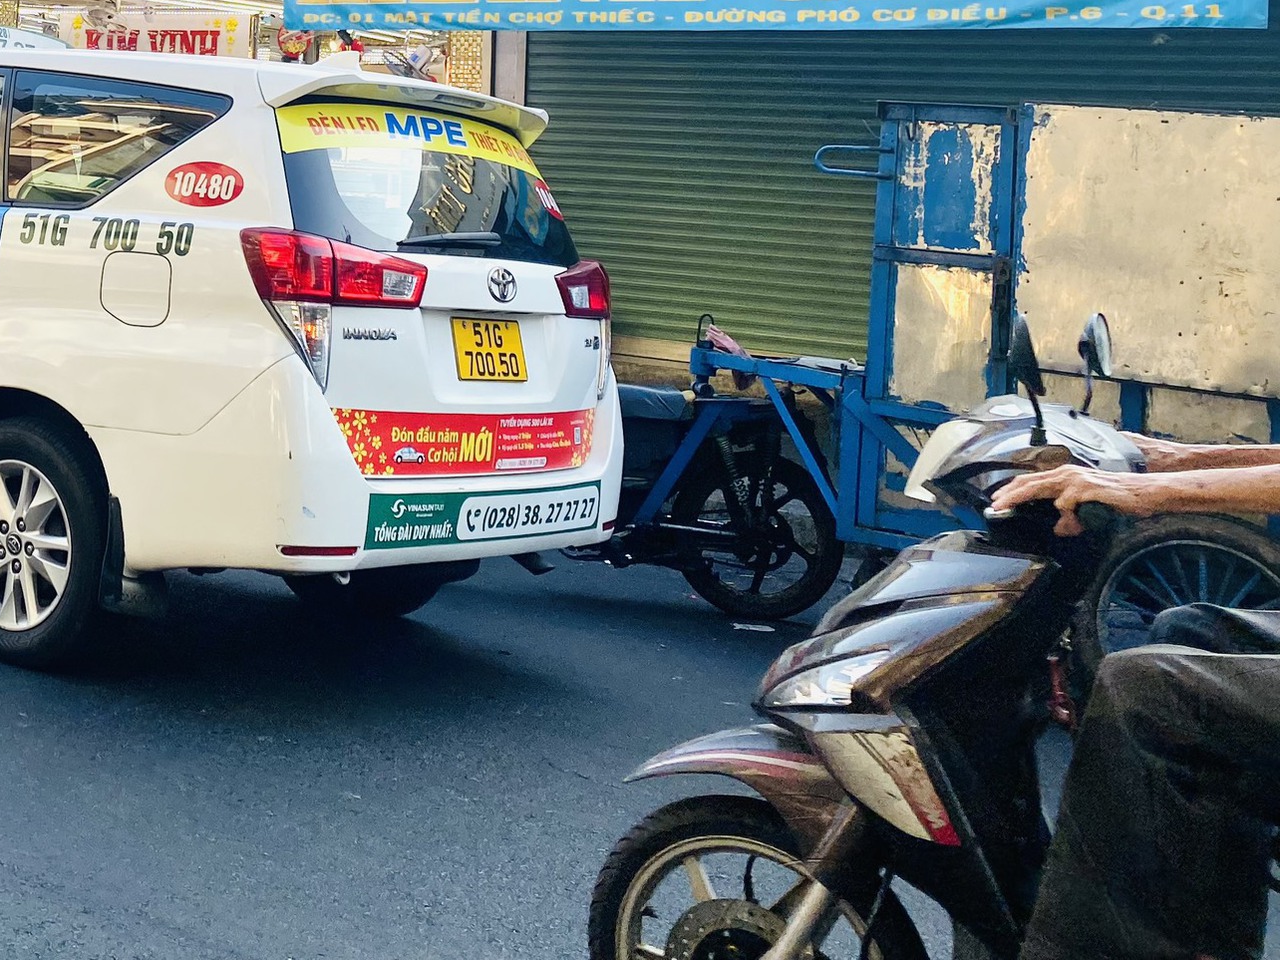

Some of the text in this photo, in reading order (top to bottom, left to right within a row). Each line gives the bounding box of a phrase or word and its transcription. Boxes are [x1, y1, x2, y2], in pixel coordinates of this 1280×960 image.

[509, 9, 563, 26] CHỢ
[572, 7, 655, 24] THIẾC
[684, 7, 786, 23] ĐƯỜNG
[872, 6, 918, 22] CƠ
[1045, 4, 1102, 20] P.6
[1141, 4, 1225, 20] Q.11
[85, 28, 220, 56] KIM VINH
[383, 112, 468, 147] MPE
[173, 171, 237, 200] 10480
[19, 212, 195, 257] 51G 700 50
[471, 322, 505, 349] 51G
[464, 351, 520, 378] 700.50
[391, 426, 414, 442] Đón
[437, 428, 459, 443] năm
[459, 426, 493, 463] MỚI
[427, 446, 458, 466] Cơ hội
[482, 504, 521, 532] (028)
[545, 502, 563, 524] 27
[563, 500, 580, 522] 27
[580, 497, 596, 520] 27
[374, 521, 398, 543] TỔNG
[397, 522, 412, 542] ĐÀI
[412, 524, 430, 541] DUY
